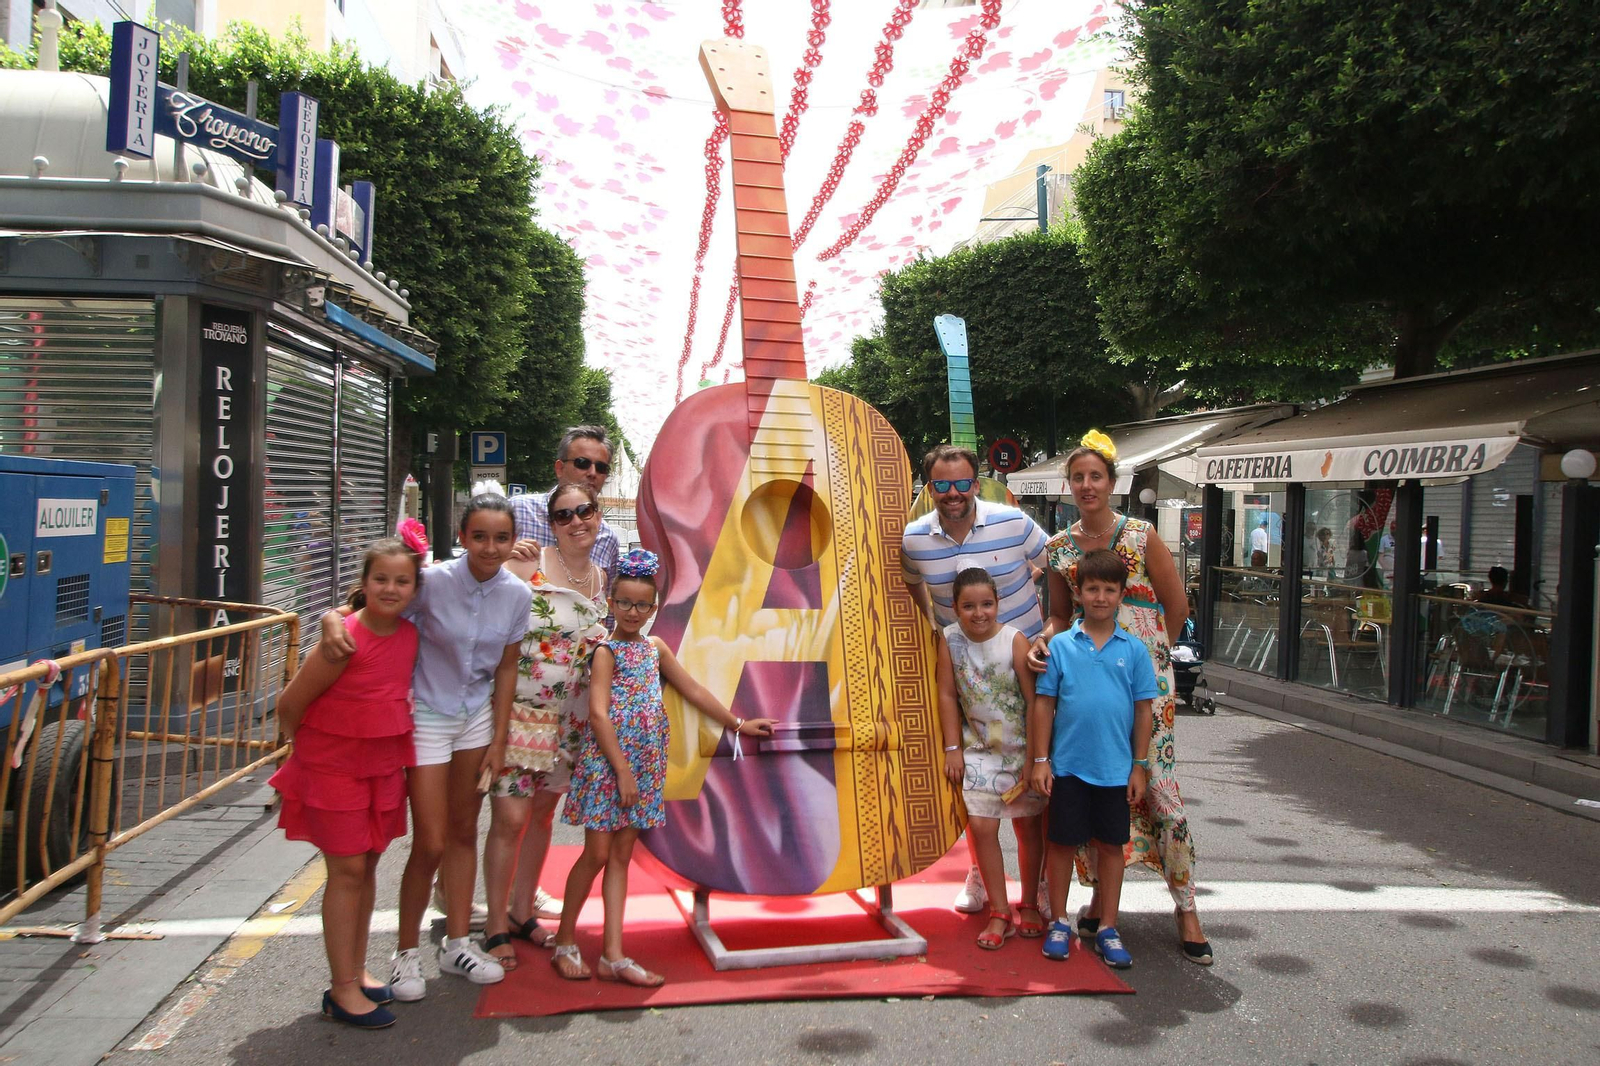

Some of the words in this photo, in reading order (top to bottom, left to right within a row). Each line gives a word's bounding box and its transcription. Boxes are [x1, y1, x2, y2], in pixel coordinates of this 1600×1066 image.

[134, 37, 150, 147] JOYERIA
[299, 99, 313, 204] RELOJERIA
[203, 328, 248, 345] TROYANO
[478, 436, 498, 461] P
[1206, 454, 1293, 481] CAFETERIA
[1363, 443, 1487, 477] COIMBRA
[1020, 481, 1048, 494] CAFETERIA
[39, 506, 95, 529] ALQUILER
